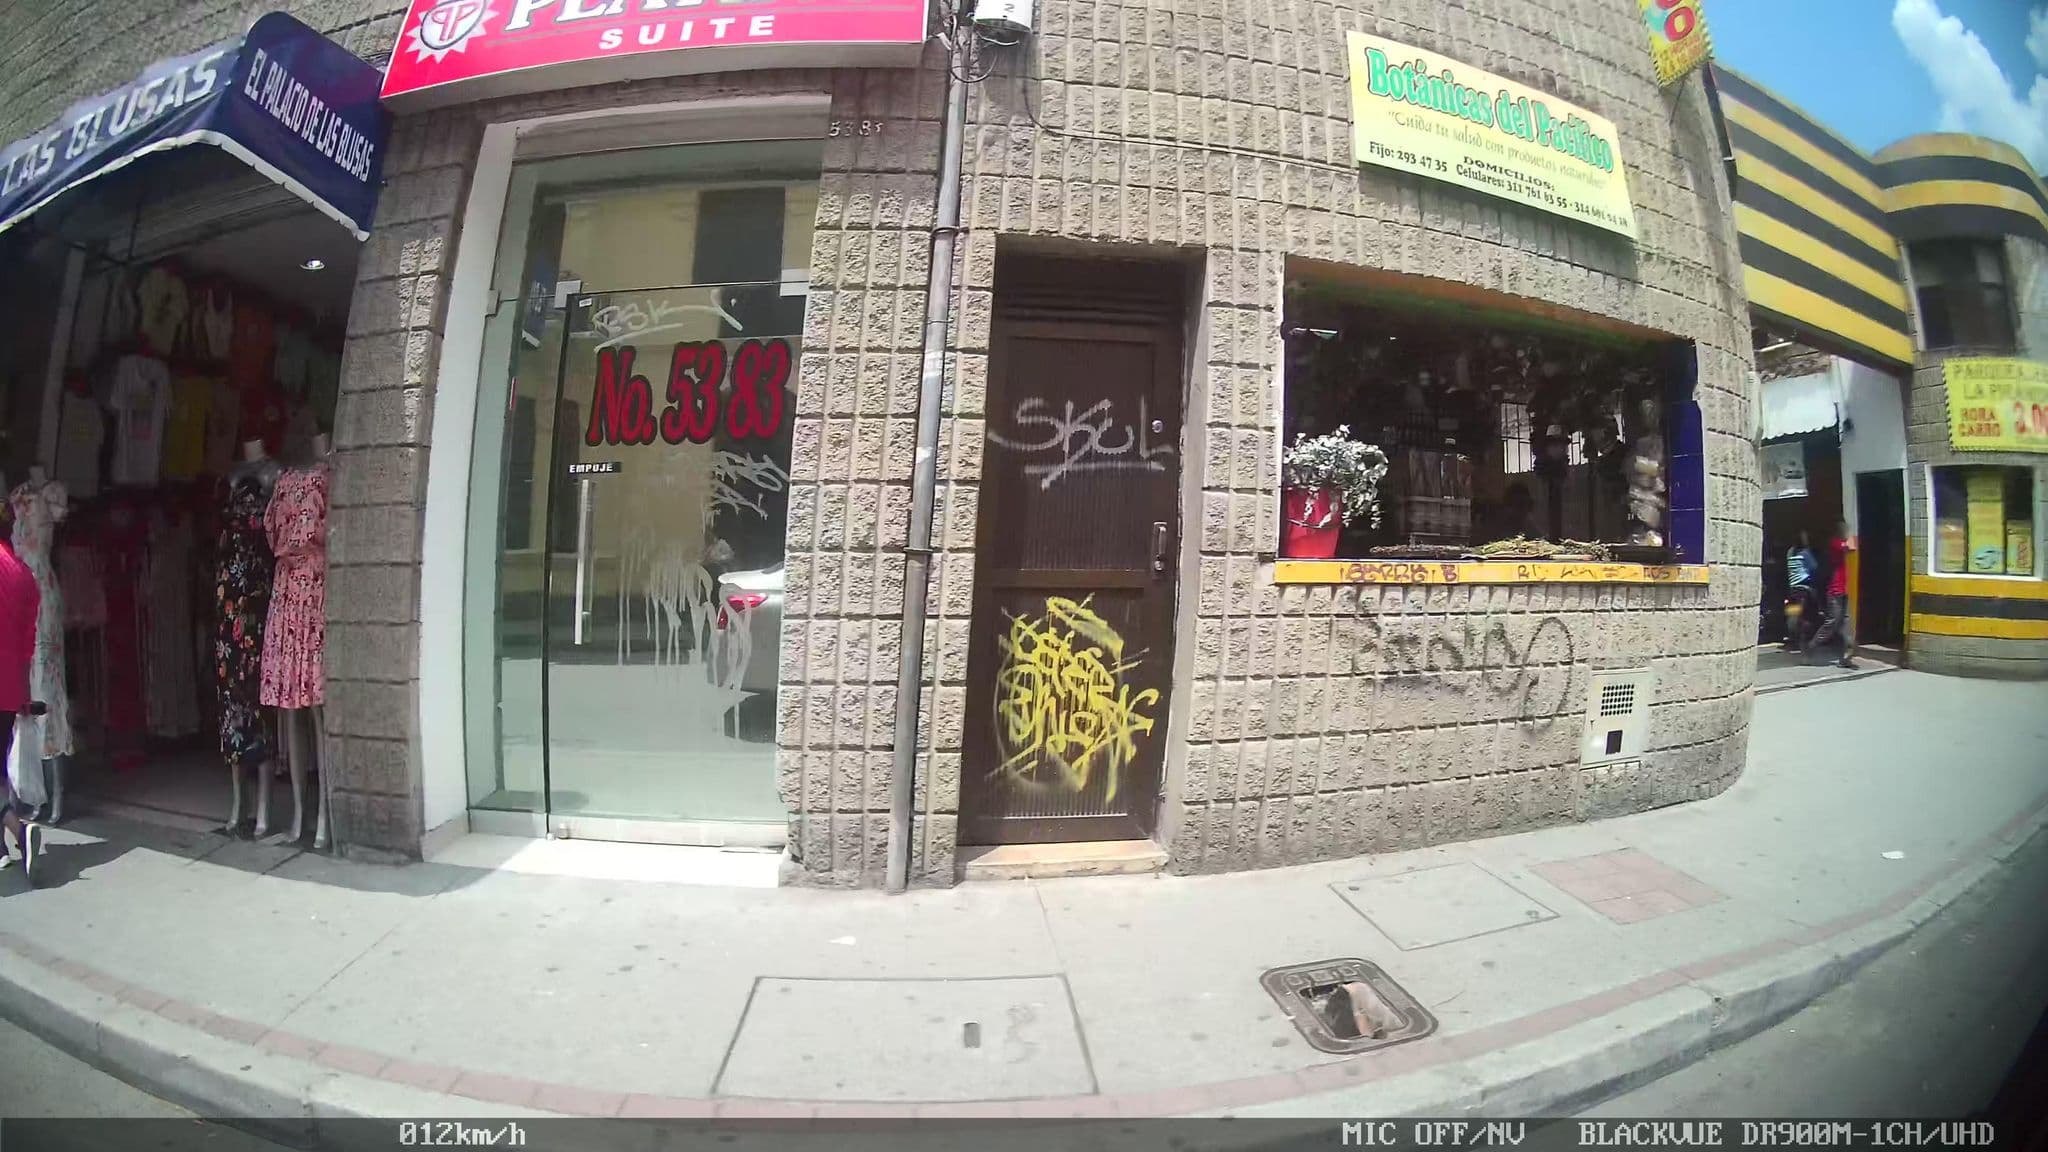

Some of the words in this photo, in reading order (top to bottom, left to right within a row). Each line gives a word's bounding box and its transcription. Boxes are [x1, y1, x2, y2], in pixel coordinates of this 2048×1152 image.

[599, 15, 775, 50] SUITE
[1, 131, 62, 197] LAS
[65, 50, 226, 161] BLUSAS
[244, 48, 267, 102] EL
[260, 61, 310, 133] PALACIO
[301, 96, 325, 145] DE
[316, 108, 342, 158] LAS
[335, 124, 375, 183] BLUSAS
[1453, 125, 1482, 148] salud
[1484, 140, 1504, 155] con
[1495, 89, 1535, 142] del
[1369, 141, 1394, 159] Fijo:
[1397, 150, 1416, 165] 293
[1420, 155, 1432, 169] 47
[1435, 159, 1447, 173] 35
[1456, 163, 1506, 188] Celulares:
[1507, 181, 1522, 194] 311
[1557, 196, 1568, 209] 55
[1463, 155, 1555, 192] DOMICILIOS:
[585, 346, 657, 446] No.
[660, 339, 727, 444] 53
[726, 338, 792, 440] 83
[569, 463, 614, 474] EMPUJE
